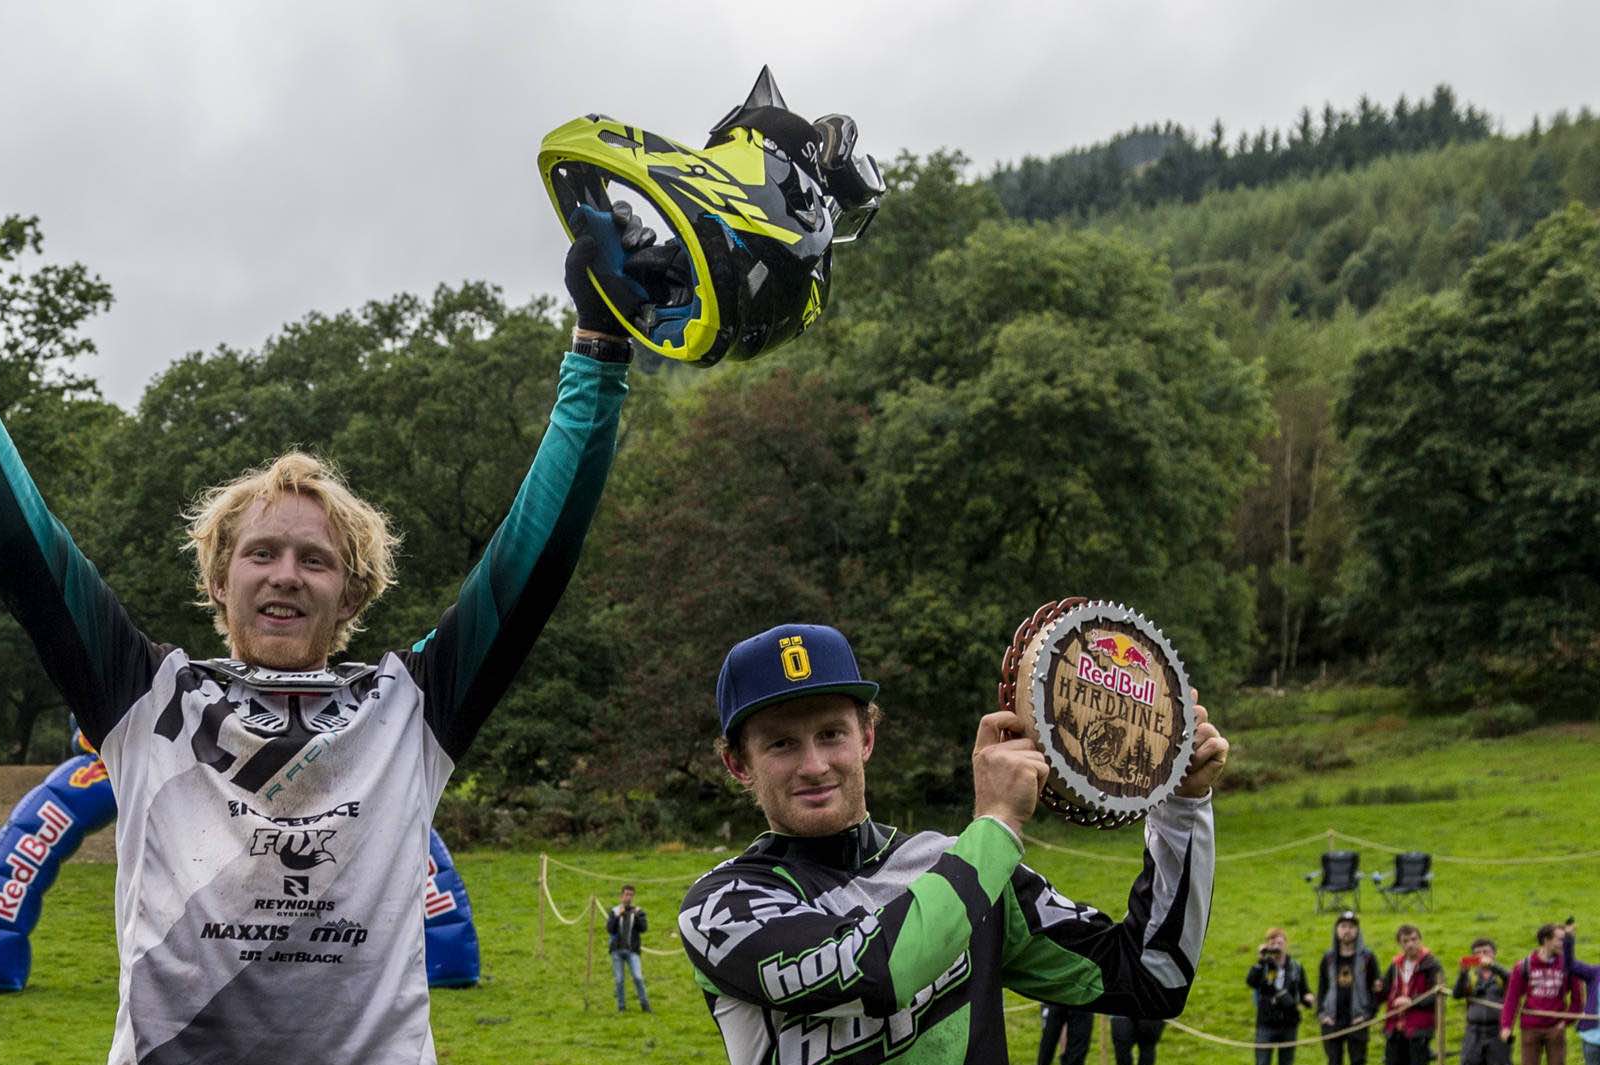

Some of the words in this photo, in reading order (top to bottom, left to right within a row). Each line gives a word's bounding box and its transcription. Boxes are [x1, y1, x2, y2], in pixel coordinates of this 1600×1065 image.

[779, 635, 812, 682] Ö
[1058, 675, 1166, 734] HARDLINE
[1123, 765, 1152, 789] 3RD
[250, 828, 338, 860] FOX
[254, 899, 336, 912] REYNOLDS
[200, 922, 291, 942] MAXXIS
